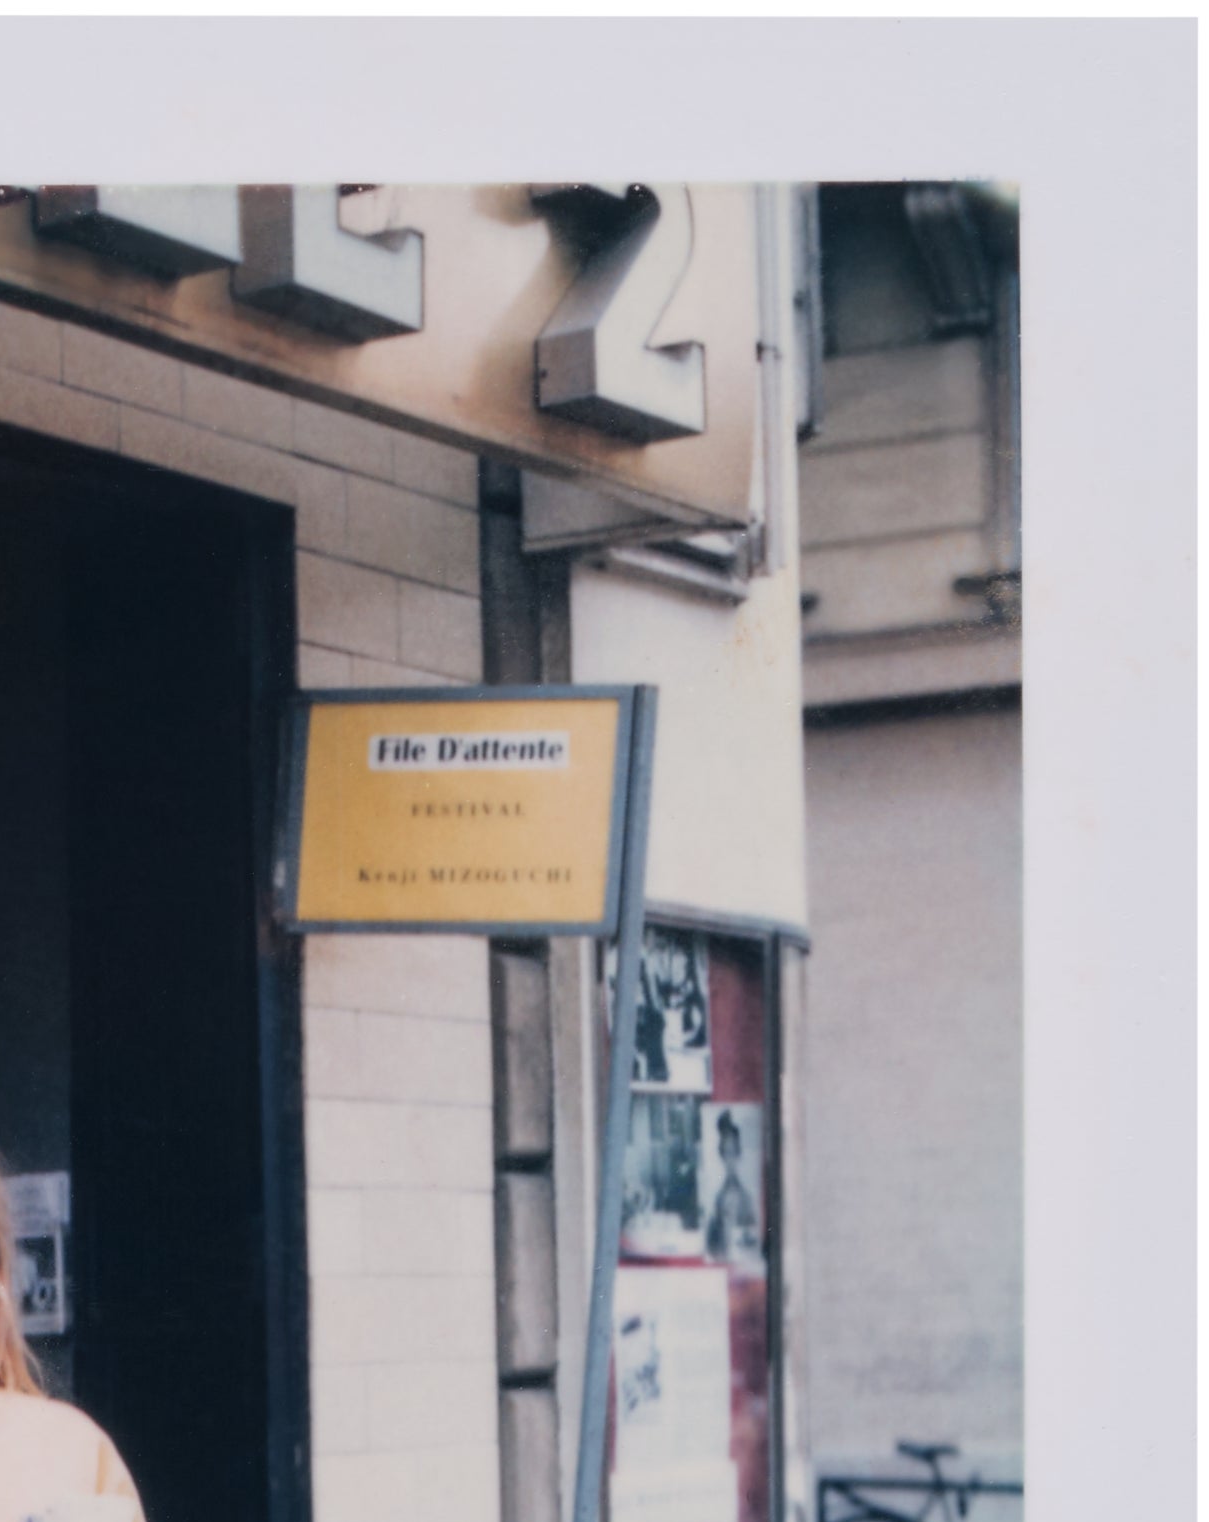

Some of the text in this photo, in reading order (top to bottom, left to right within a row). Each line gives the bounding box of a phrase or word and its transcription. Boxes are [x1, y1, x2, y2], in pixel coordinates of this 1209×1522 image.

[377, 736, 563, 763] File D'attente
[411, 802, 525, 817] FESTIVAL
[358, 867, 572, 886] Kenji MIZOGUCHI
